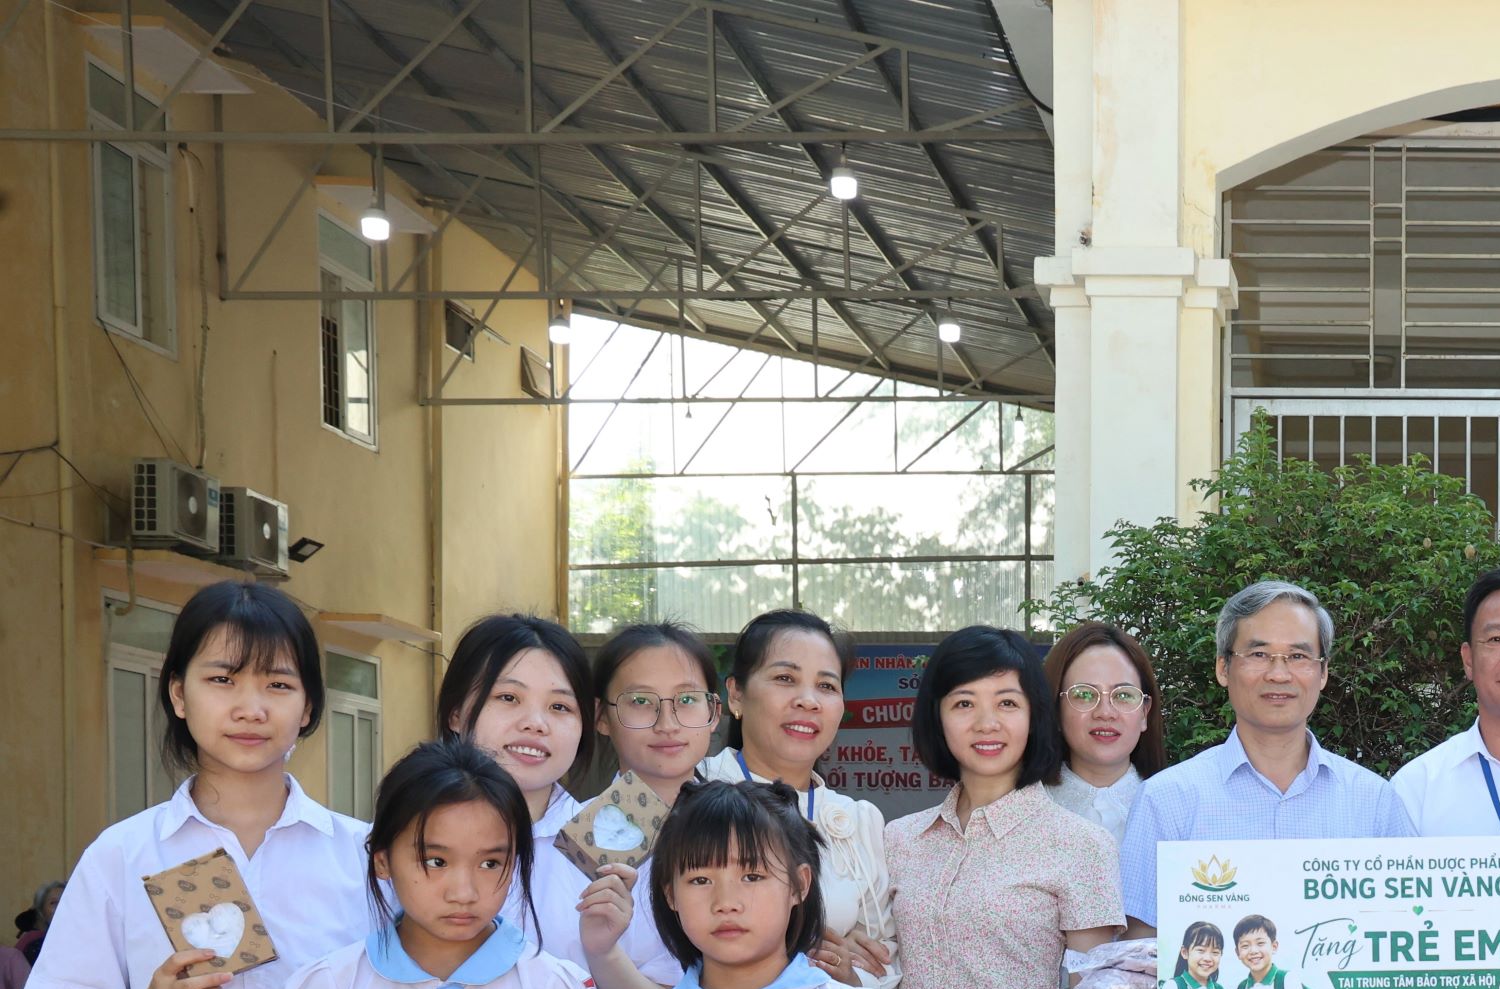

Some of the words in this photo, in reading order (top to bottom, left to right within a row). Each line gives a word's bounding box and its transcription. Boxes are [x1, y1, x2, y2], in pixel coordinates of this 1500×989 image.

[862, 701, 915, 724] CHƯƠ
[854, 769, 922, 792] TƯỢNG
[1303, 858, 1340, 872] CÔNG
[1344, 859, 1360, 871] TY
[1364, 854, 1383, 871] CỔ
[1428, 857, 1466, 872] DƯỢC
[1179, 894, 1204, 903] BÔNG
[1206, 894, 1223, 902] SEN
[1303, 874, 1376, 900] BÔNG
[1384, 877, 1432, 899] SEN
[1294, 918, 1364, 970] Tặng
[1364, 920, 1440, 962] TRẺ
[1338, 977, 1354, 989] TẠI
[1356, 977, 1390, 988] TRUNG
[1393, 974, 1414, 988] TÂM
[1417, 973, 1437, 987] BẢO
[1439, 976, 1460, 989] TRỢ
[1462, 974, 1476, 986] XÃ
[1479, 973, 1496, 989] HỘI
